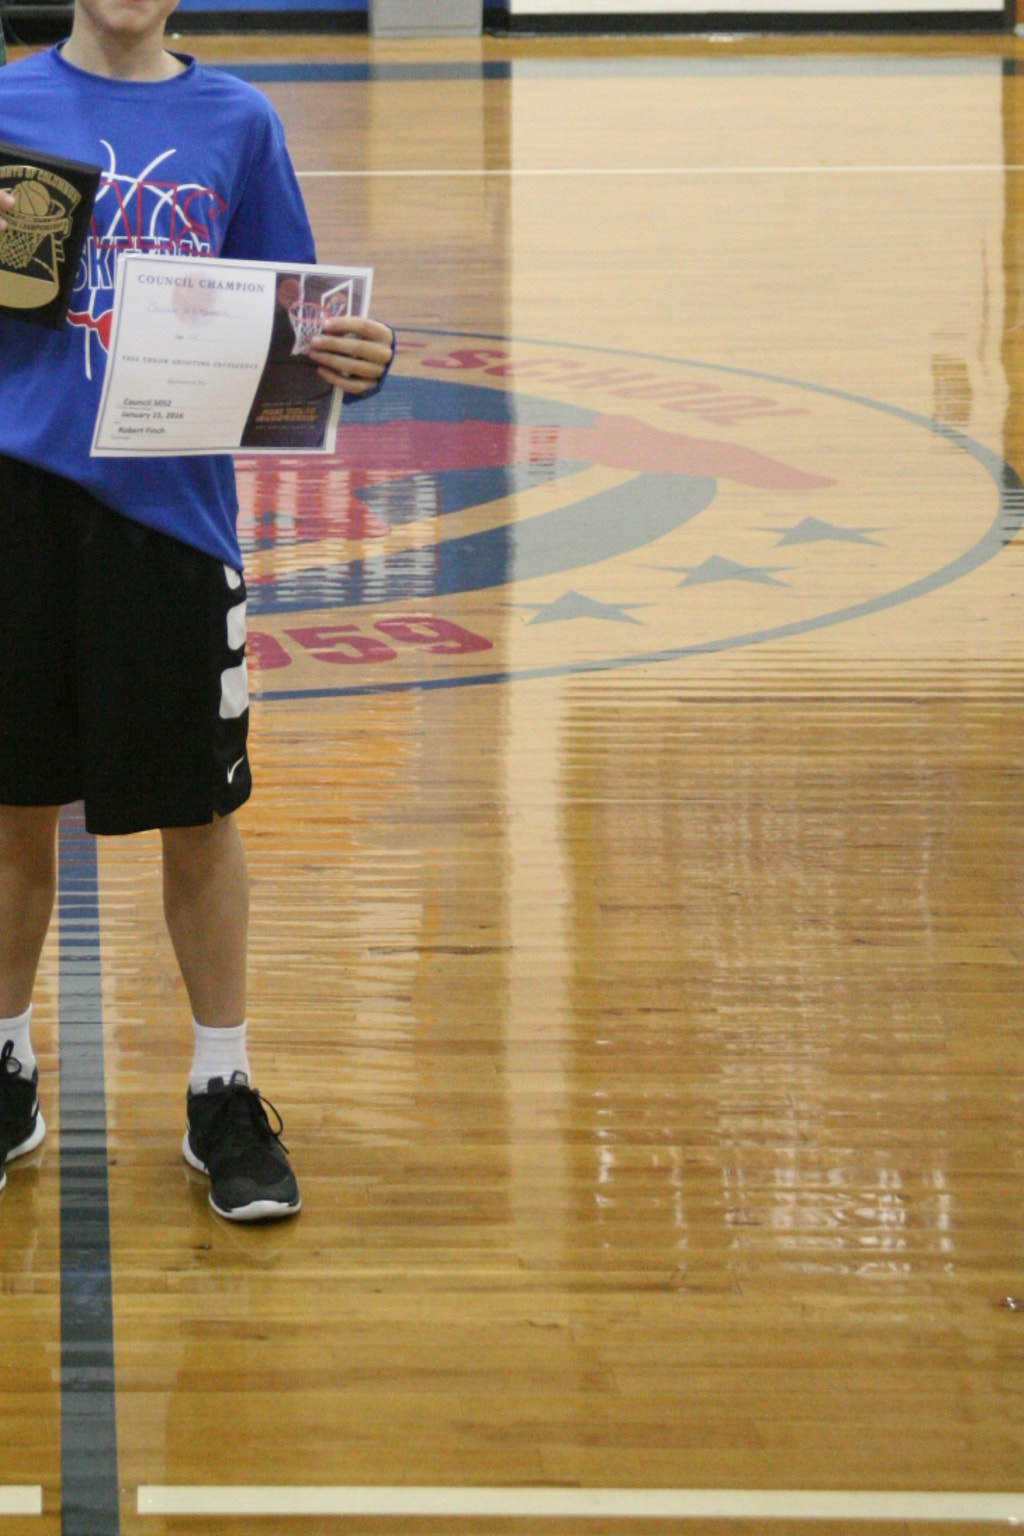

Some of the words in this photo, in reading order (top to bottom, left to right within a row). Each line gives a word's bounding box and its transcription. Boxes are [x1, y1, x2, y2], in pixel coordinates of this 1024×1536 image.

[137, 273, 194, 289] COUNCIL
[198, 278, 265, 294] CHAMPION
[123, 398, 152, 407] Council
[121, 411, 150, 421] January
[118, 426, 145, 434] Robert
